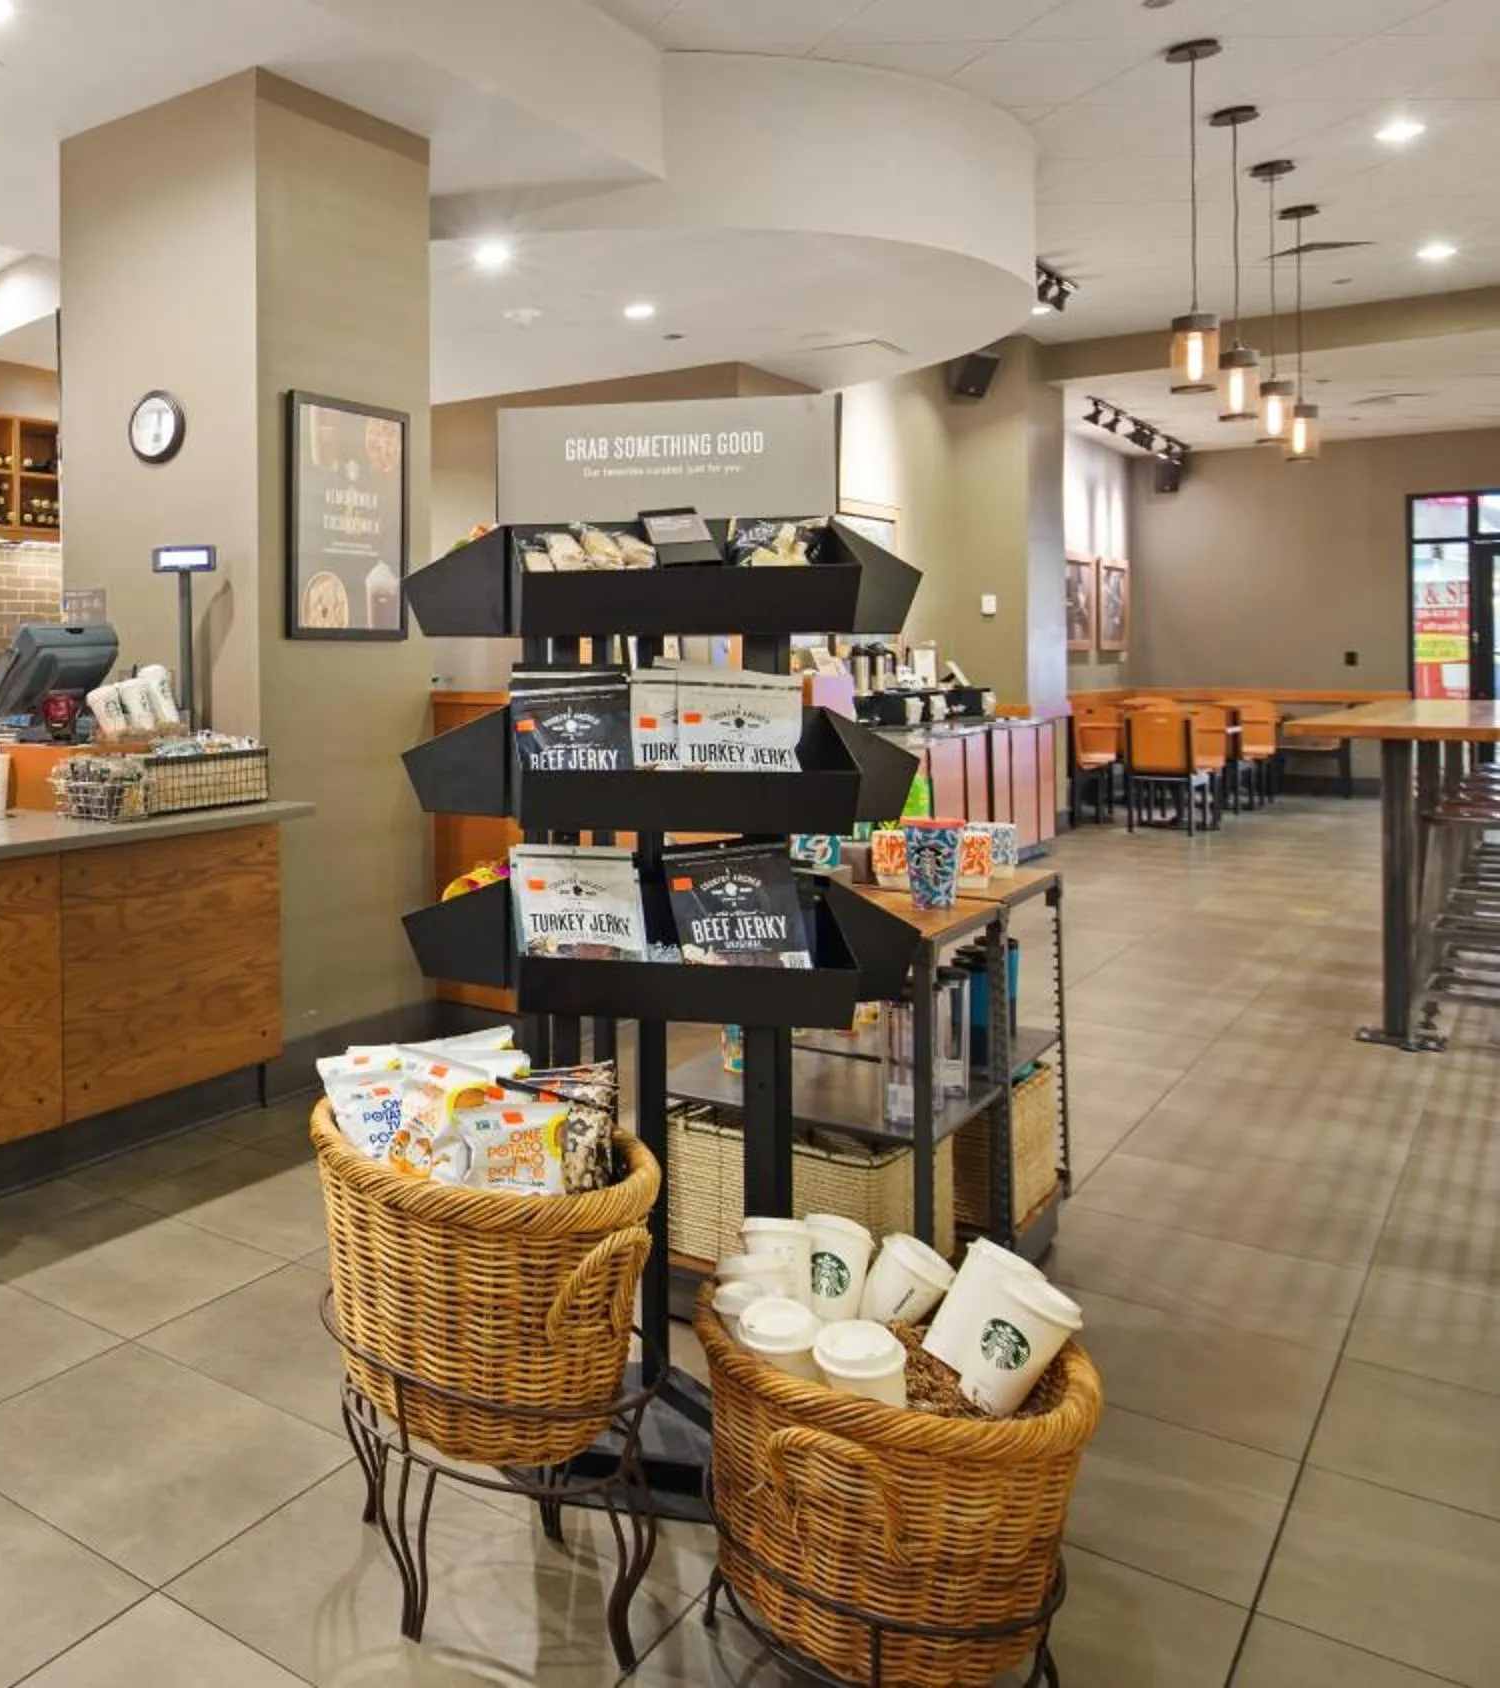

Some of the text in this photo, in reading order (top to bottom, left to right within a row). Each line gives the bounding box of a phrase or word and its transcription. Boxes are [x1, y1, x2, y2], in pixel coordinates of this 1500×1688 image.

[565, 431, 763, 461] GRAB SOMETHING GOOD
[530, 749, 618, 771] BEEF JERKY
[641, 742, 679, 762] TURK
[689, 743, 745, 763] TURKEY
[529, 913, 585, 933] TURKEY
[590, 913, 631, 937] JERKY
[691, 915, 787, 943] BEEF JERKY
[510, 1127, 543, 1143] ONE
